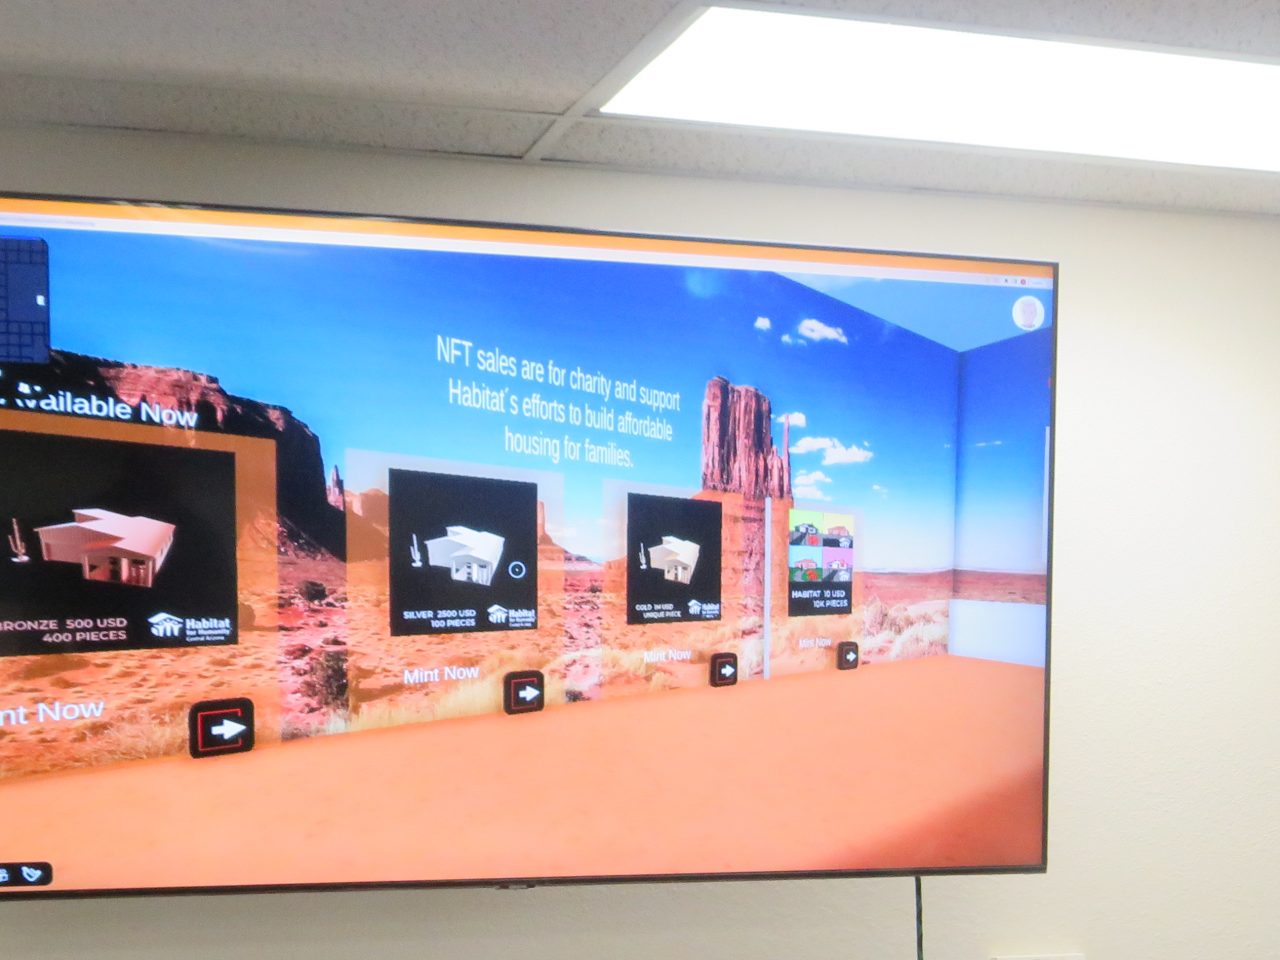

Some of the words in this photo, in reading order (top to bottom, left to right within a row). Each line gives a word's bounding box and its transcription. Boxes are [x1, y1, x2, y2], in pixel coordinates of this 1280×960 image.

[437, 335, 473, 367] NFT
[477, 348, 517, 377] sales
[521, 360, 544, 383] are
[548, 360, 566, 387] for
[570, 366, 612, 402] charity
[614, 380, 637, 402] and
[639, 385, 681, 413] support
[0, 390, 132, 420] vailable
[140, 402, 199, 428] Now
[522, 393, 566, 424] efforts
[569, 403, 582, 426] to
[585, 403, 614, 431] build
[618, 411, 673, 442] affordable
[505, 425, 560, 464] housing
[564, 435, 581, 461] for
[584, 438, 634, 468] families.
[791, 590, 821, 599] HABITAT
[826, 599, 848, 608] PIECES
[403, 610, 434, 619] SILVER
[437, 609, 457, 618] 2500
[458, 609, 477, 618] USD
[0, 618, 59, 632] RONZE
[66, 619, 94, 630] 500
[97, 617, 128, 628] USD
[185, 617, 231, 630] Habitat
[431, 619, 446, 628] 100
[446, 618, 476, 627] PIECES
[42, 632, 73, 643] 400
[75, 631, 128, 642] PIECES
[403, 668, 439, 685] Mint
[444, 666, 480, 680] Now
[0, 705, 29, 727] nt
[37, 699, 105, 724] Now
